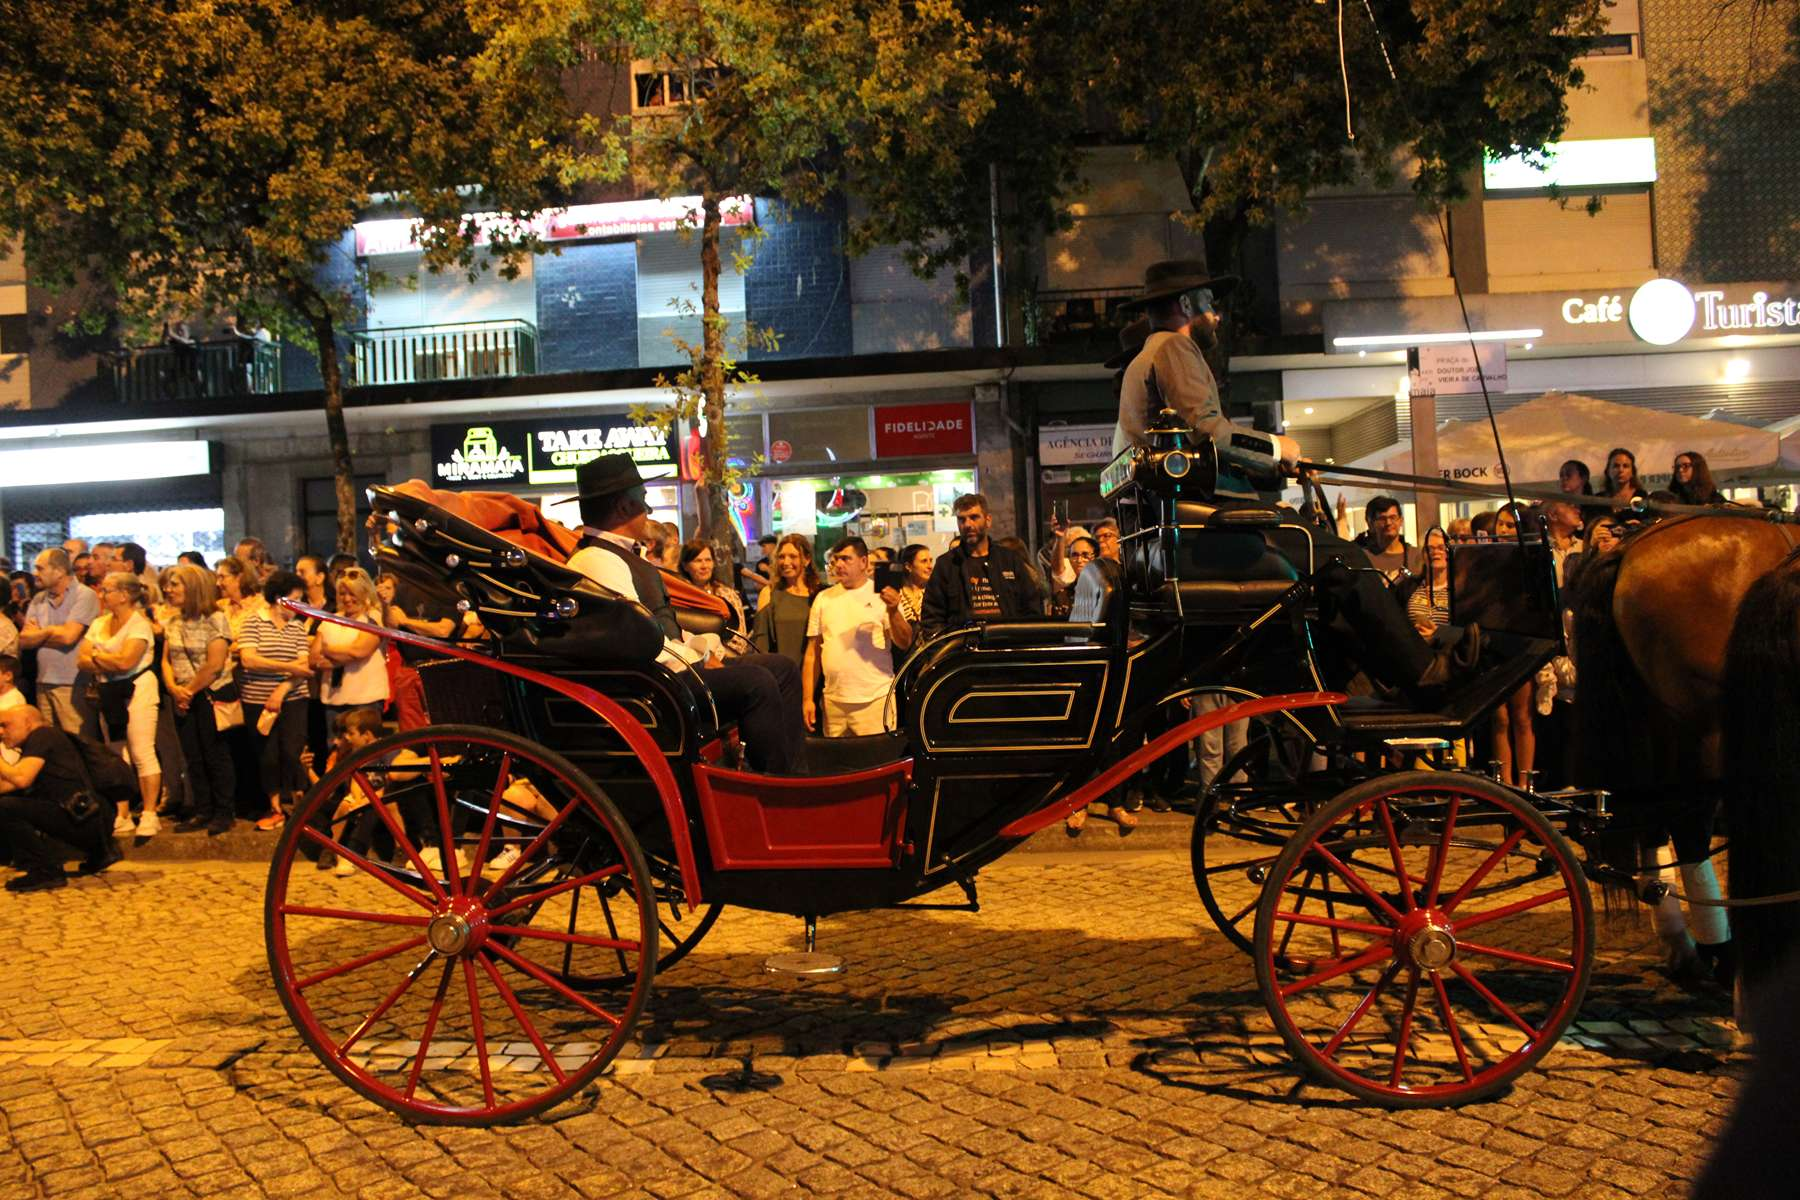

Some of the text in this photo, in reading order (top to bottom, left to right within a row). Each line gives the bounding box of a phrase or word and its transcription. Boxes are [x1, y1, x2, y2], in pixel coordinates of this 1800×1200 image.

[1562, 290, 1800, 330] Café Turist
[1436, 366, 1465, 375] DOUTOR
[1438, 375, 1459, 384] VIEIRA
[1461, 375, 1470, 383] DE
[884, 419, 963, 434] FIDELIDADE
[538, 425, 667, 452] TAKE AWAY
[1047, 435, 1098, 450] AGÊNCIA
[437, 460, 525, 477] MIRAMAIA
[1453, 467, 1488, 479] BOCK
